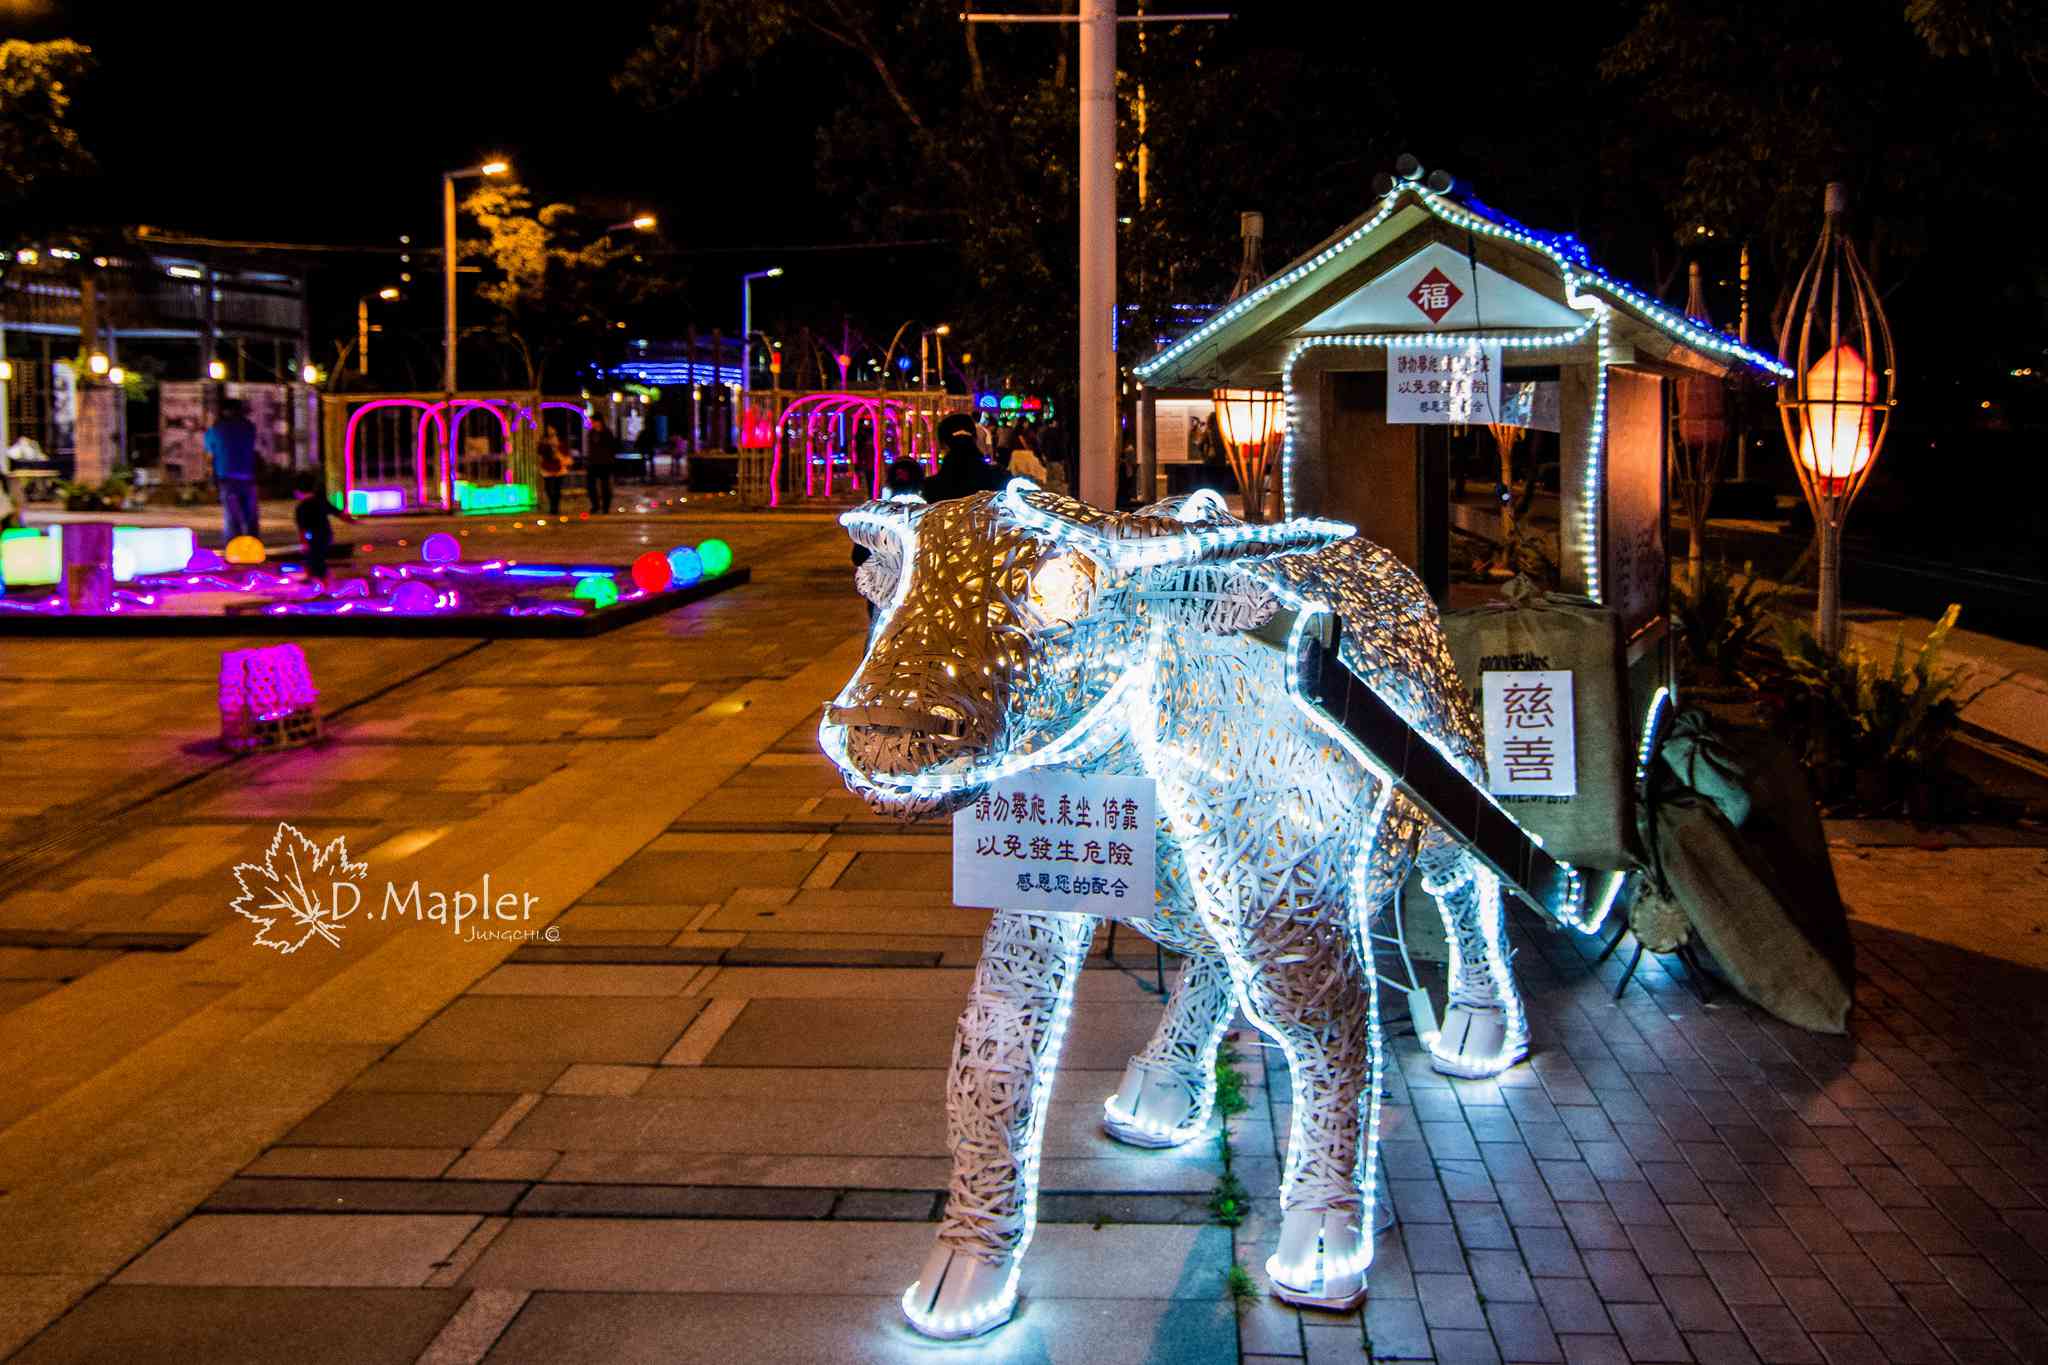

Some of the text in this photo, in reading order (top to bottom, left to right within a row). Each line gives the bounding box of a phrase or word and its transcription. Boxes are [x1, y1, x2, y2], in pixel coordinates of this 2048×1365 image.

[1418, 282, 1450, 311] 福
[1503, 683, 1555, 783] 慈善
[976, 834, 1134, 866] 以免發生危險
[1016, 872, 1129, 898] 感恩您的配合
